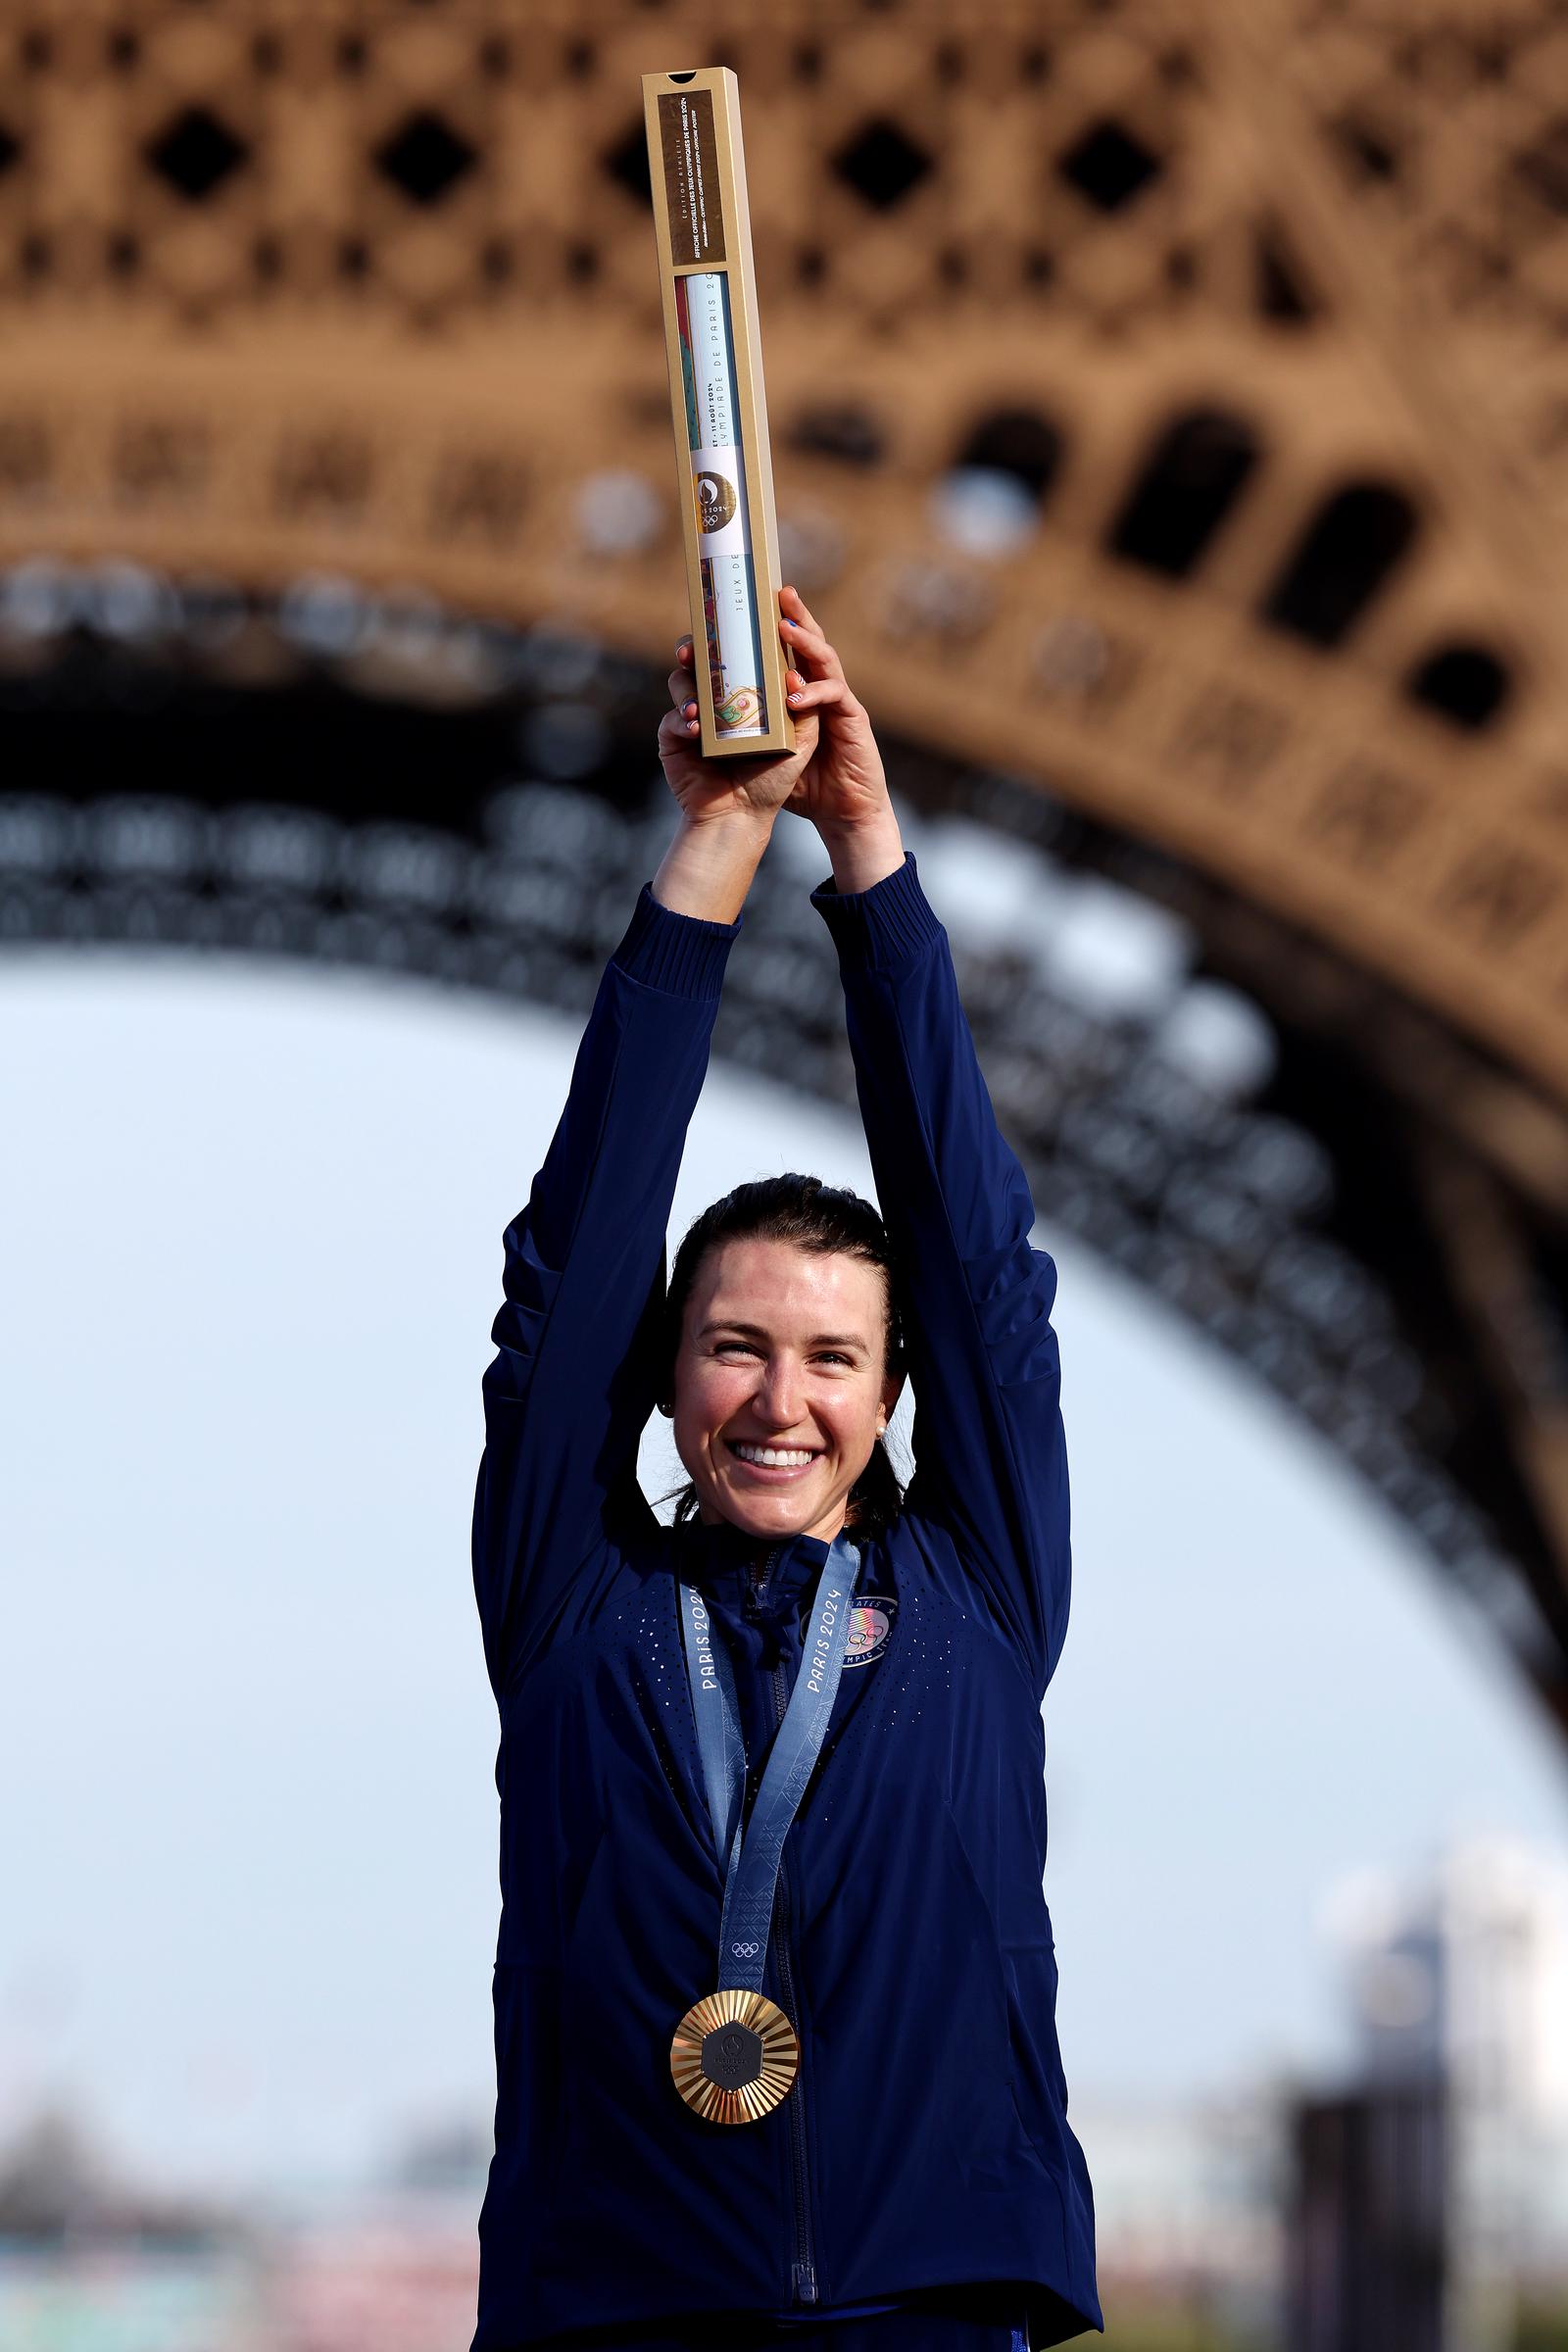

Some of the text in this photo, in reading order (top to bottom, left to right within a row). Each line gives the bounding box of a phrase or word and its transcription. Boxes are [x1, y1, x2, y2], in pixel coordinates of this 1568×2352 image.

[684, 140, 693, 176] OLYMPIQUES
[708, 299, 718, 341] PARIS
[712, 352, 721, 367] DE
[733, 579, 743, 612] JEUX
[819, 1589, 842, 1638] 2024
